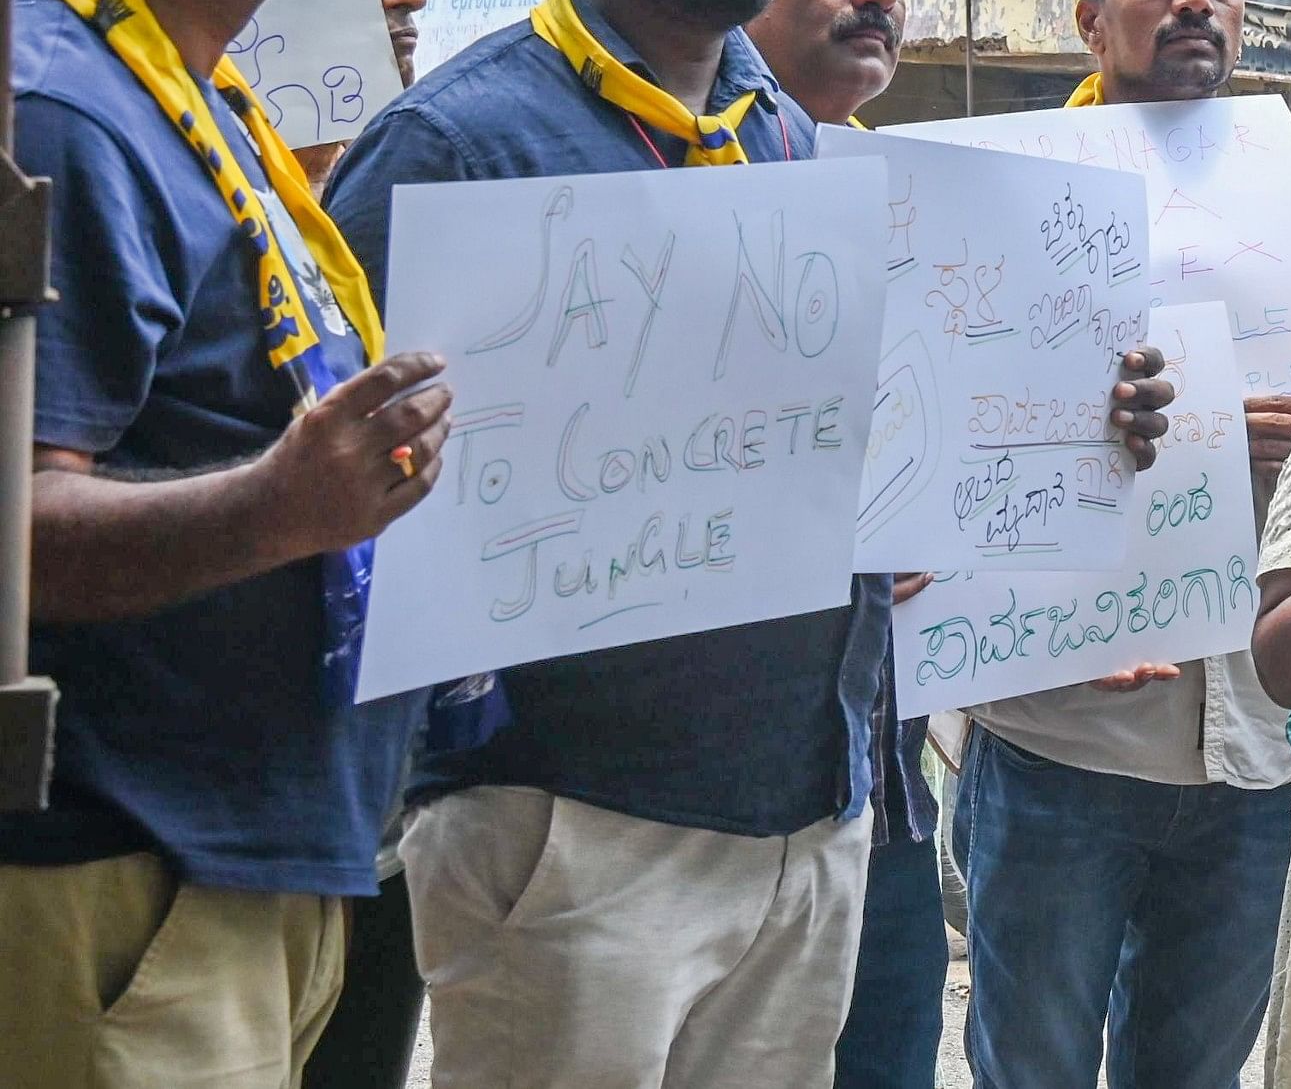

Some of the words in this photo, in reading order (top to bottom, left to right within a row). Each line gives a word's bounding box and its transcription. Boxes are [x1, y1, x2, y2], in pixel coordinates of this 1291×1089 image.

[465, 184, 677, 400] SAY
[712, 209, 840, 382] NO
[449, 401, 524, 507] TO
[556, 396, 845, 503] CONCRETE
[480, 509, 735, 623] JUNGLE
